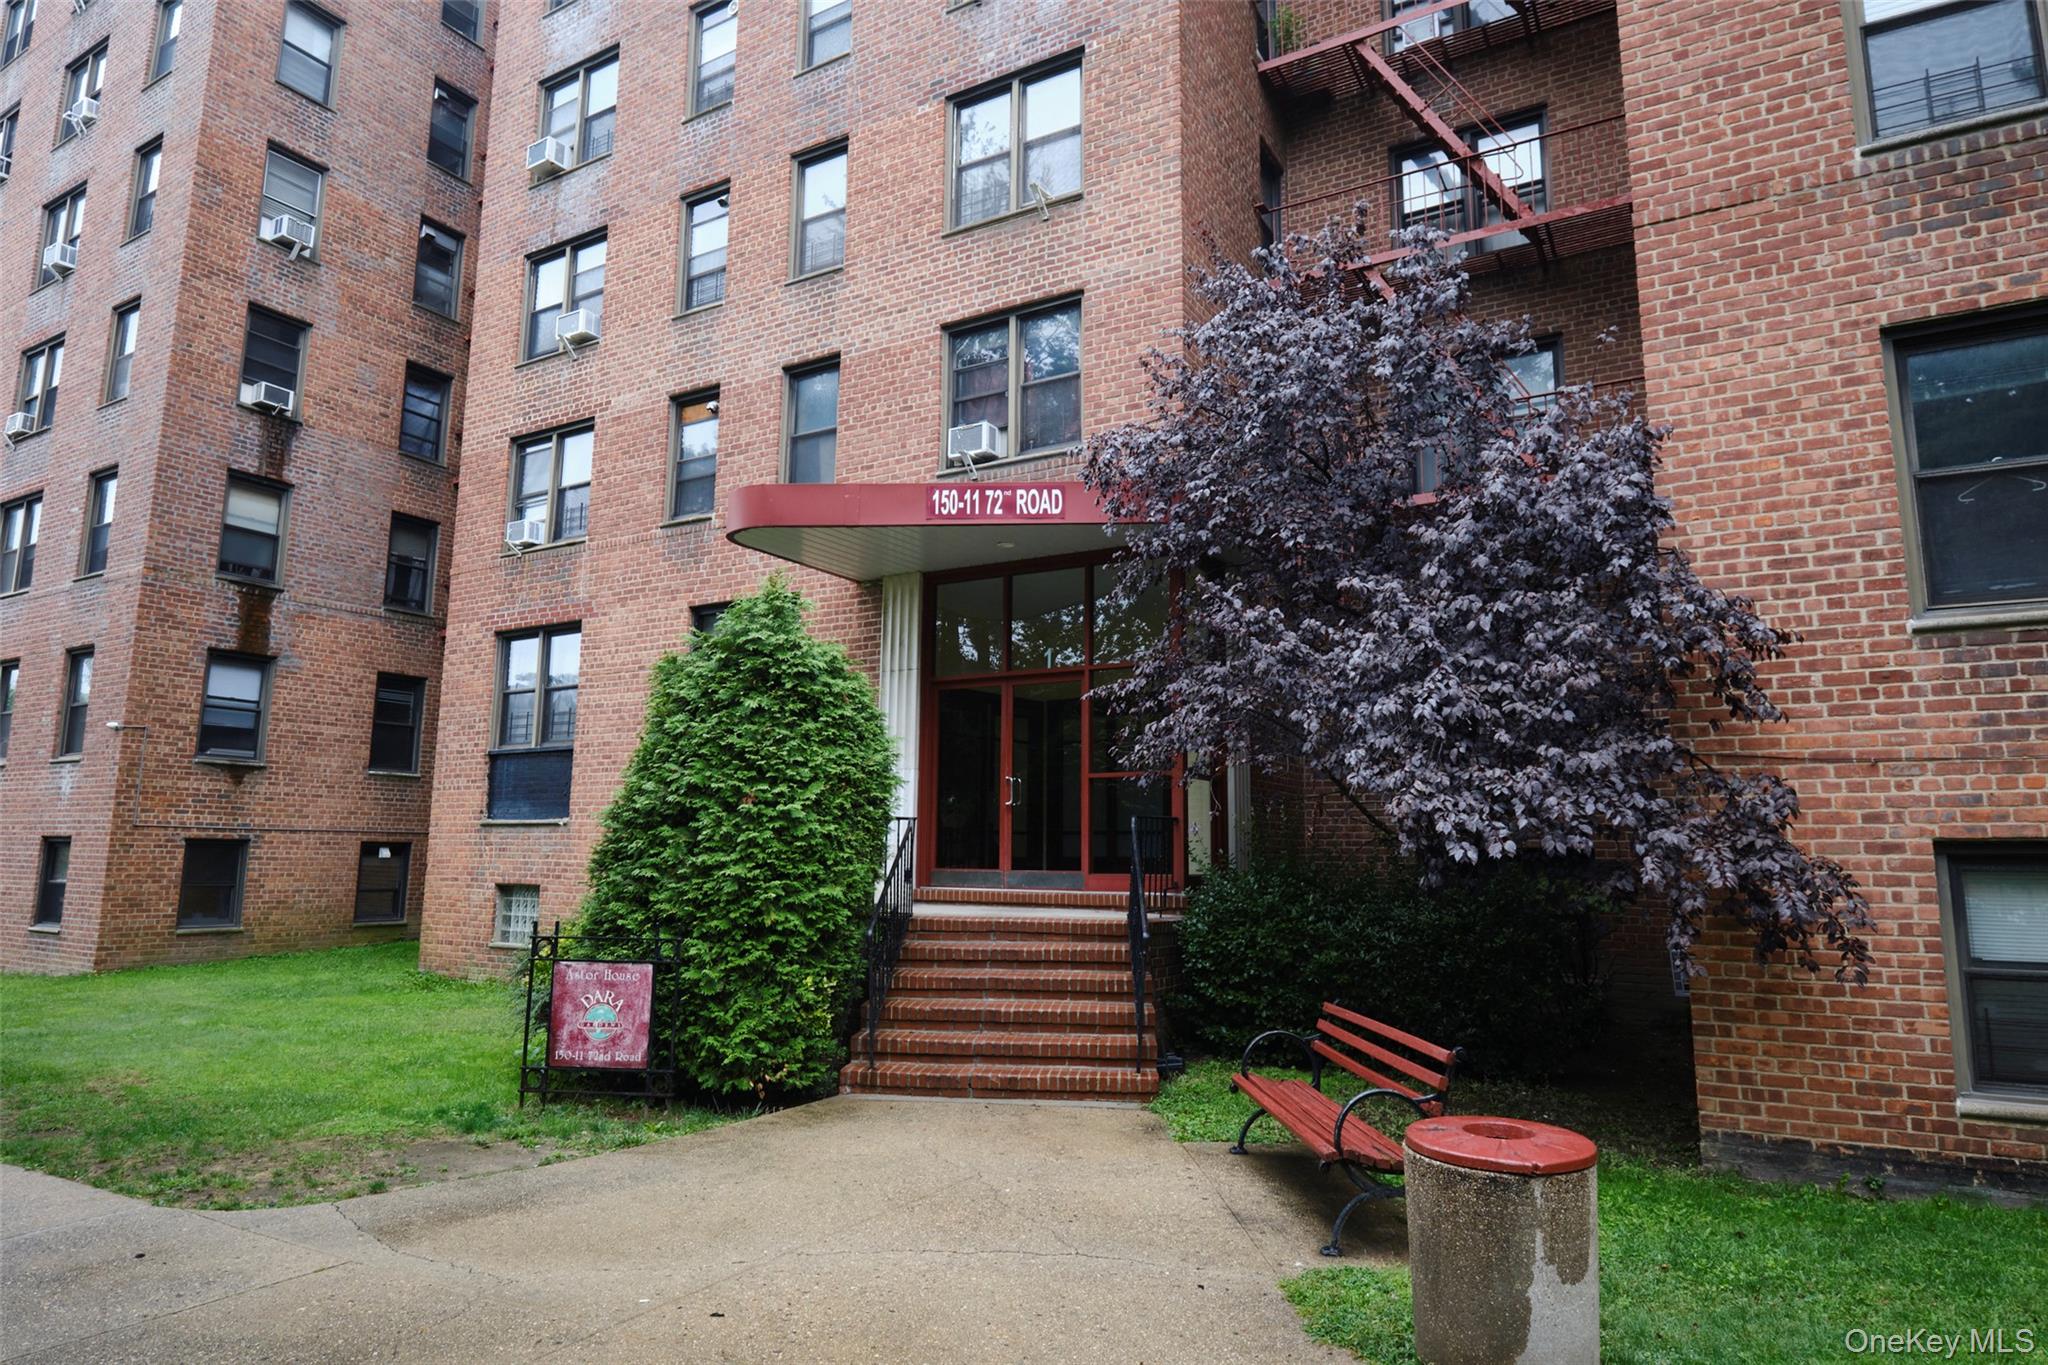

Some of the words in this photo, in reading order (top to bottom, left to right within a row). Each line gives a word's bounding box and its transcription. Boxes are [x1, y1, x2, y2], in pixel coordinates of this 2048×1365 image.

[932, 489, 979, 515] 150-11
[985, 489, 1012, 515] 72nd
[1016, 488, 1063, 515] ROAD
[566, 970, 598, 981] Astor
[604, 969, 640, 981] House
[580, 990, 624, 1012] DARA
[555, 1050, 584, 1060] 150-11
[615, 1050, 641, 1061] Road
